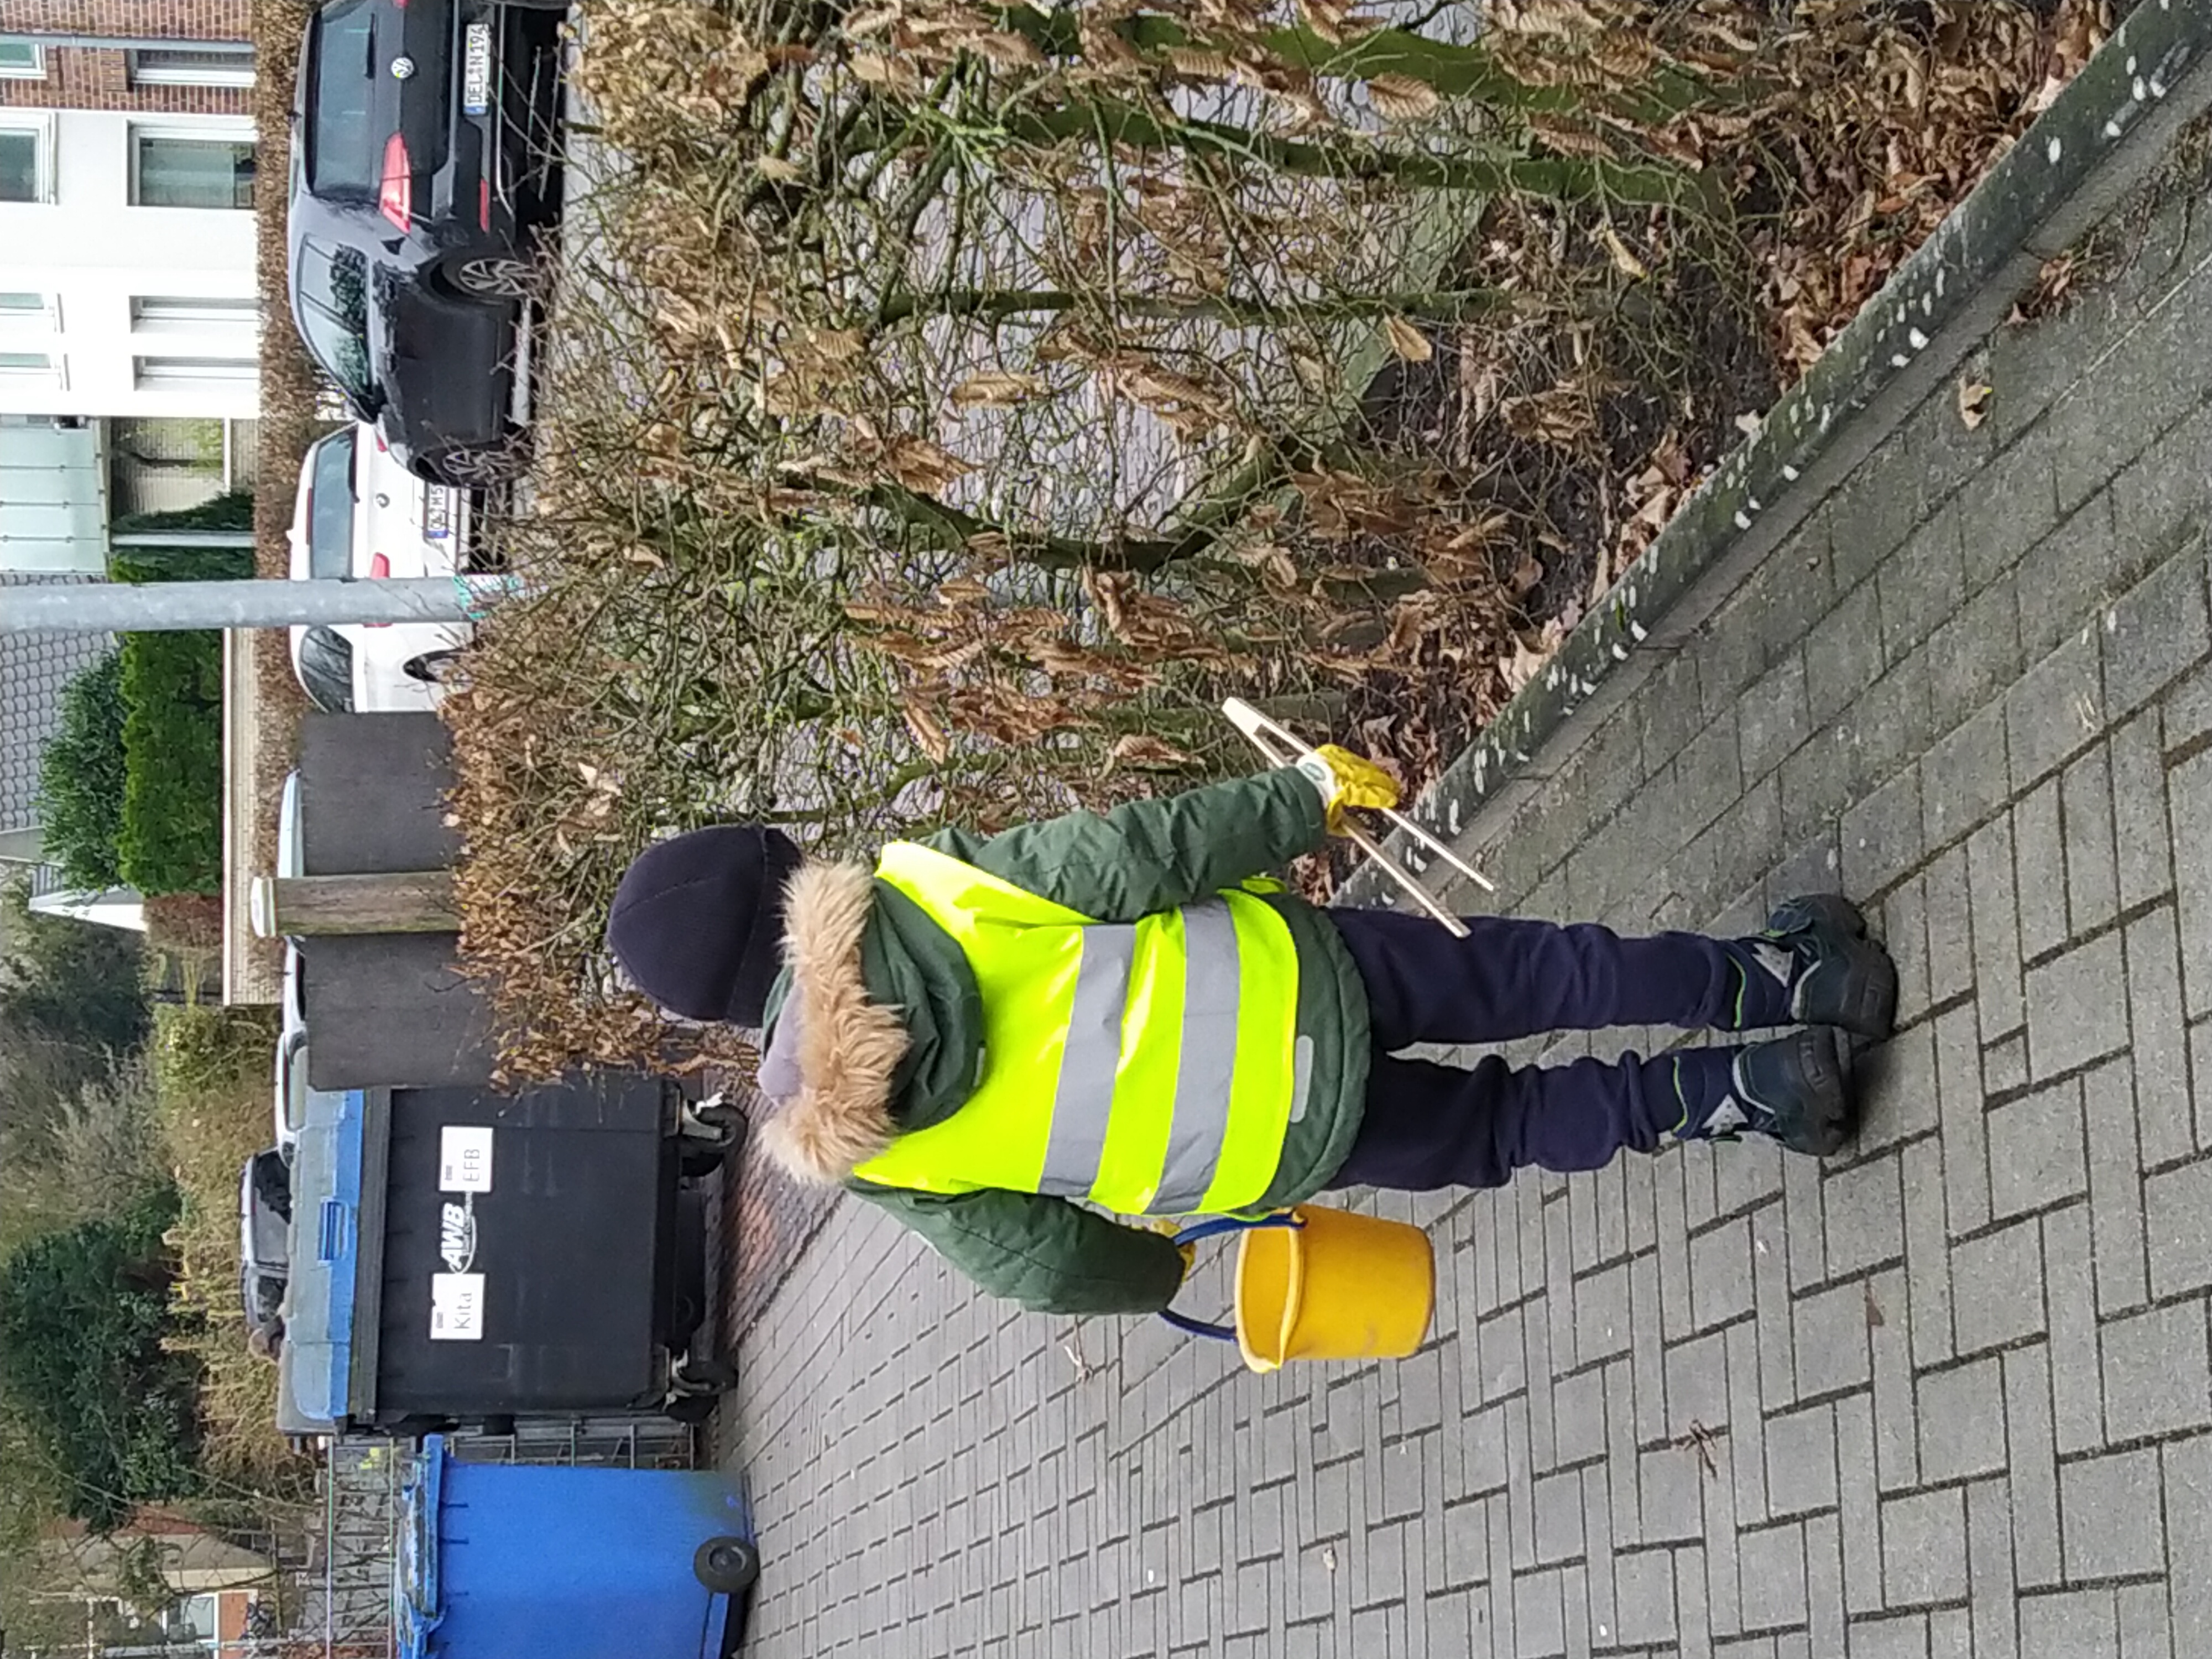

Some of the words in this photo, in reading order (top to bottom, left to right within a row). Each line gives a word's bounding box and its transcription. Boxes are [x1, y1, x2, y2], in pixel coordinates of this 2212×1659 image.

[469, 55, 483, 66] N
[468, 74, 483, 103] DEL
[431, 497, 443, 505] M
[462, 1149, 480, 1182] EFB
[441, 1202, 463, 1270] AWB
[453, 1292, 472, 1329] Kita
